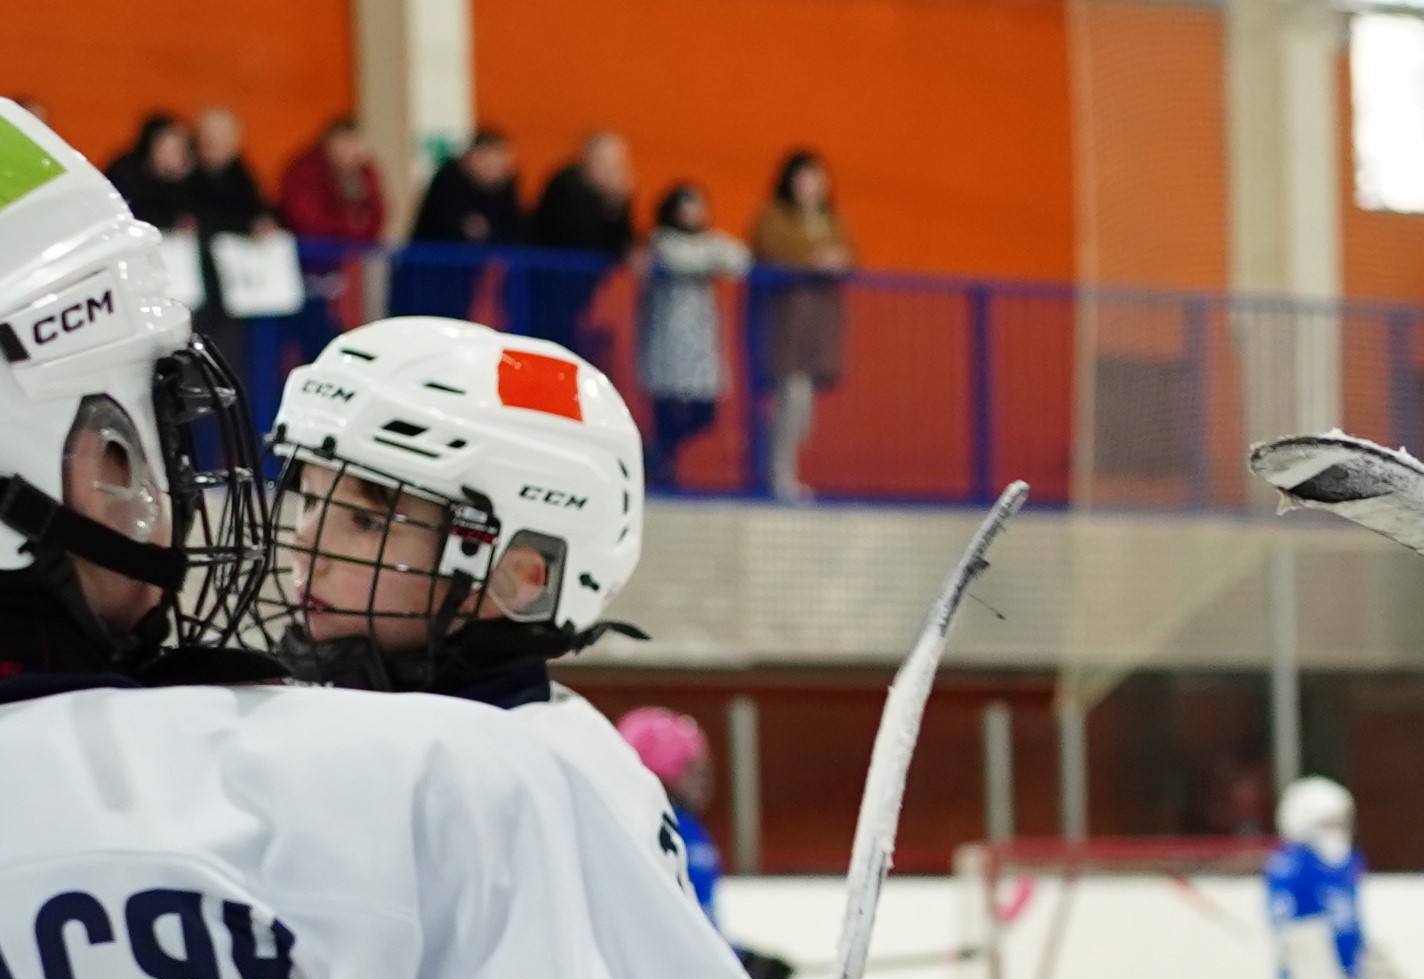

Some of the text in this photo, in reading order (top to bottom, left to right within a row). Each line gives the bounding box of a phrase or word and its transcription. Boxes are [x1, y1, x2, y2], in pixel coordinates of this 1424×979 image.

[33, 289, 113, 345] CCM
[302, 379, 356, 403] CCM
[519, 486, 588, 509] CCM
